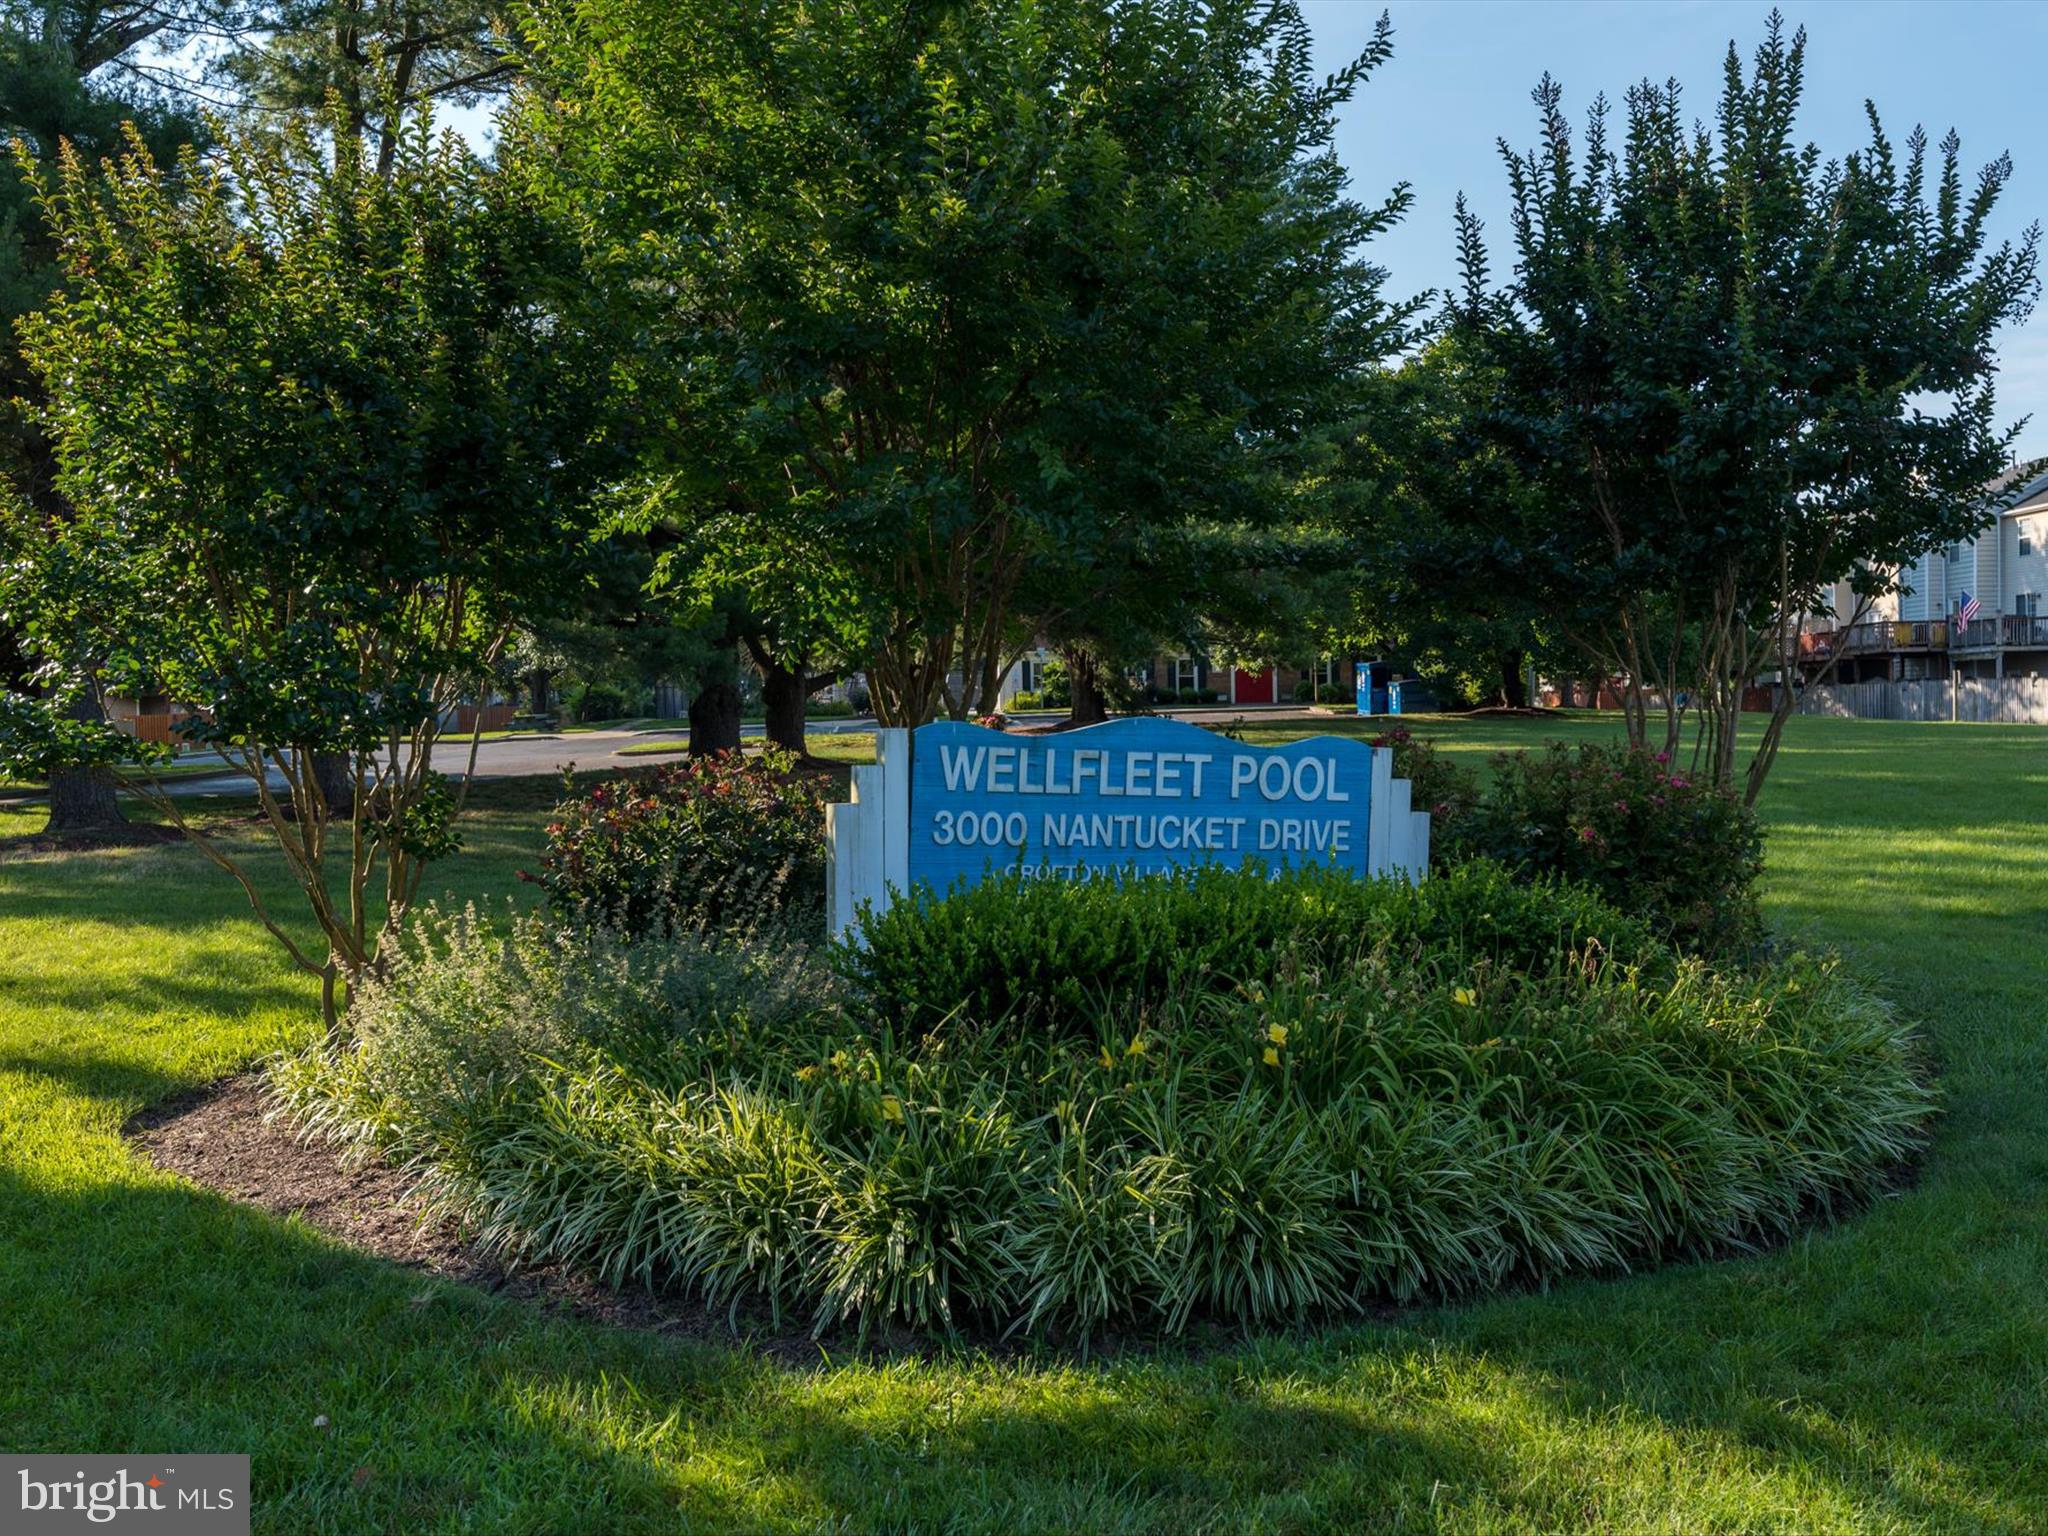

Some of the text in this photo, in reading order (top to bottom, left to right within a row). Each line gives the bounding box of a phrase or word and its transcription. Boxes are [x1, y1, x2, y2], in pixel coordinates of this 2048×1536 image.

[940, 745, 1349, 801] WELLFLEET POOL
[933, 810, 1350, 851] 3000 NANTUCKET DRIVE
